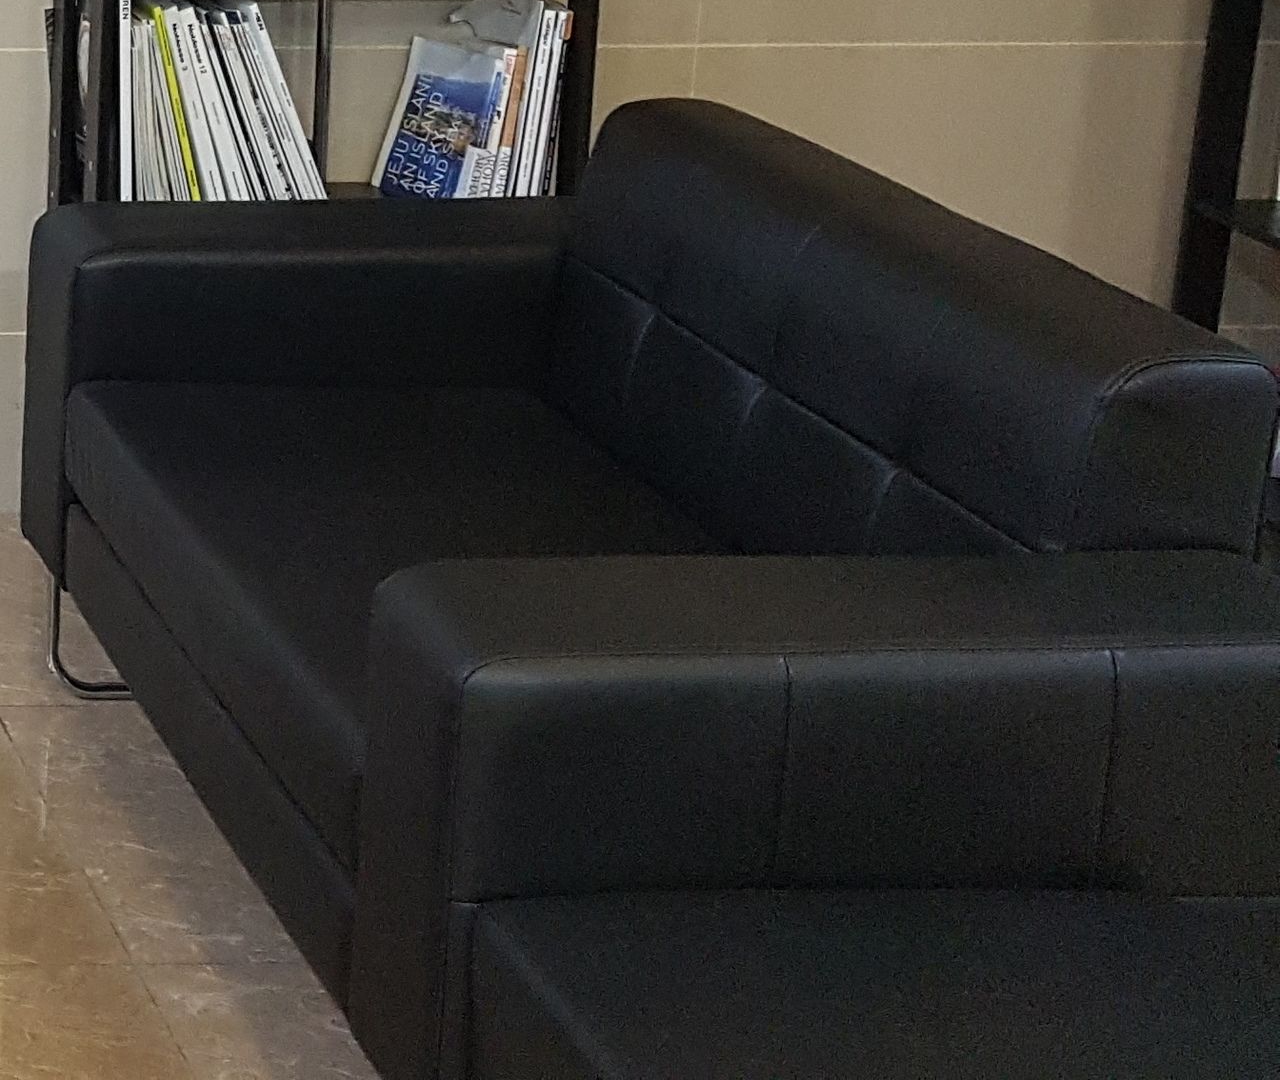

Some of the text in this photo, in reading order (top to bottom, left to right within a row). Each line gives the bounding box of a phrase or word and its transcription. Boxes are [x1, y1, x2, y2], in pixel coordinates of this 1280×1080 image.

[385, 139, 409, 186] JEJU
[399, 91, 445, 191] AN ISLAND
[412, 129, 445, 195] OF SKY
[426, 159, 450, 198] AND
